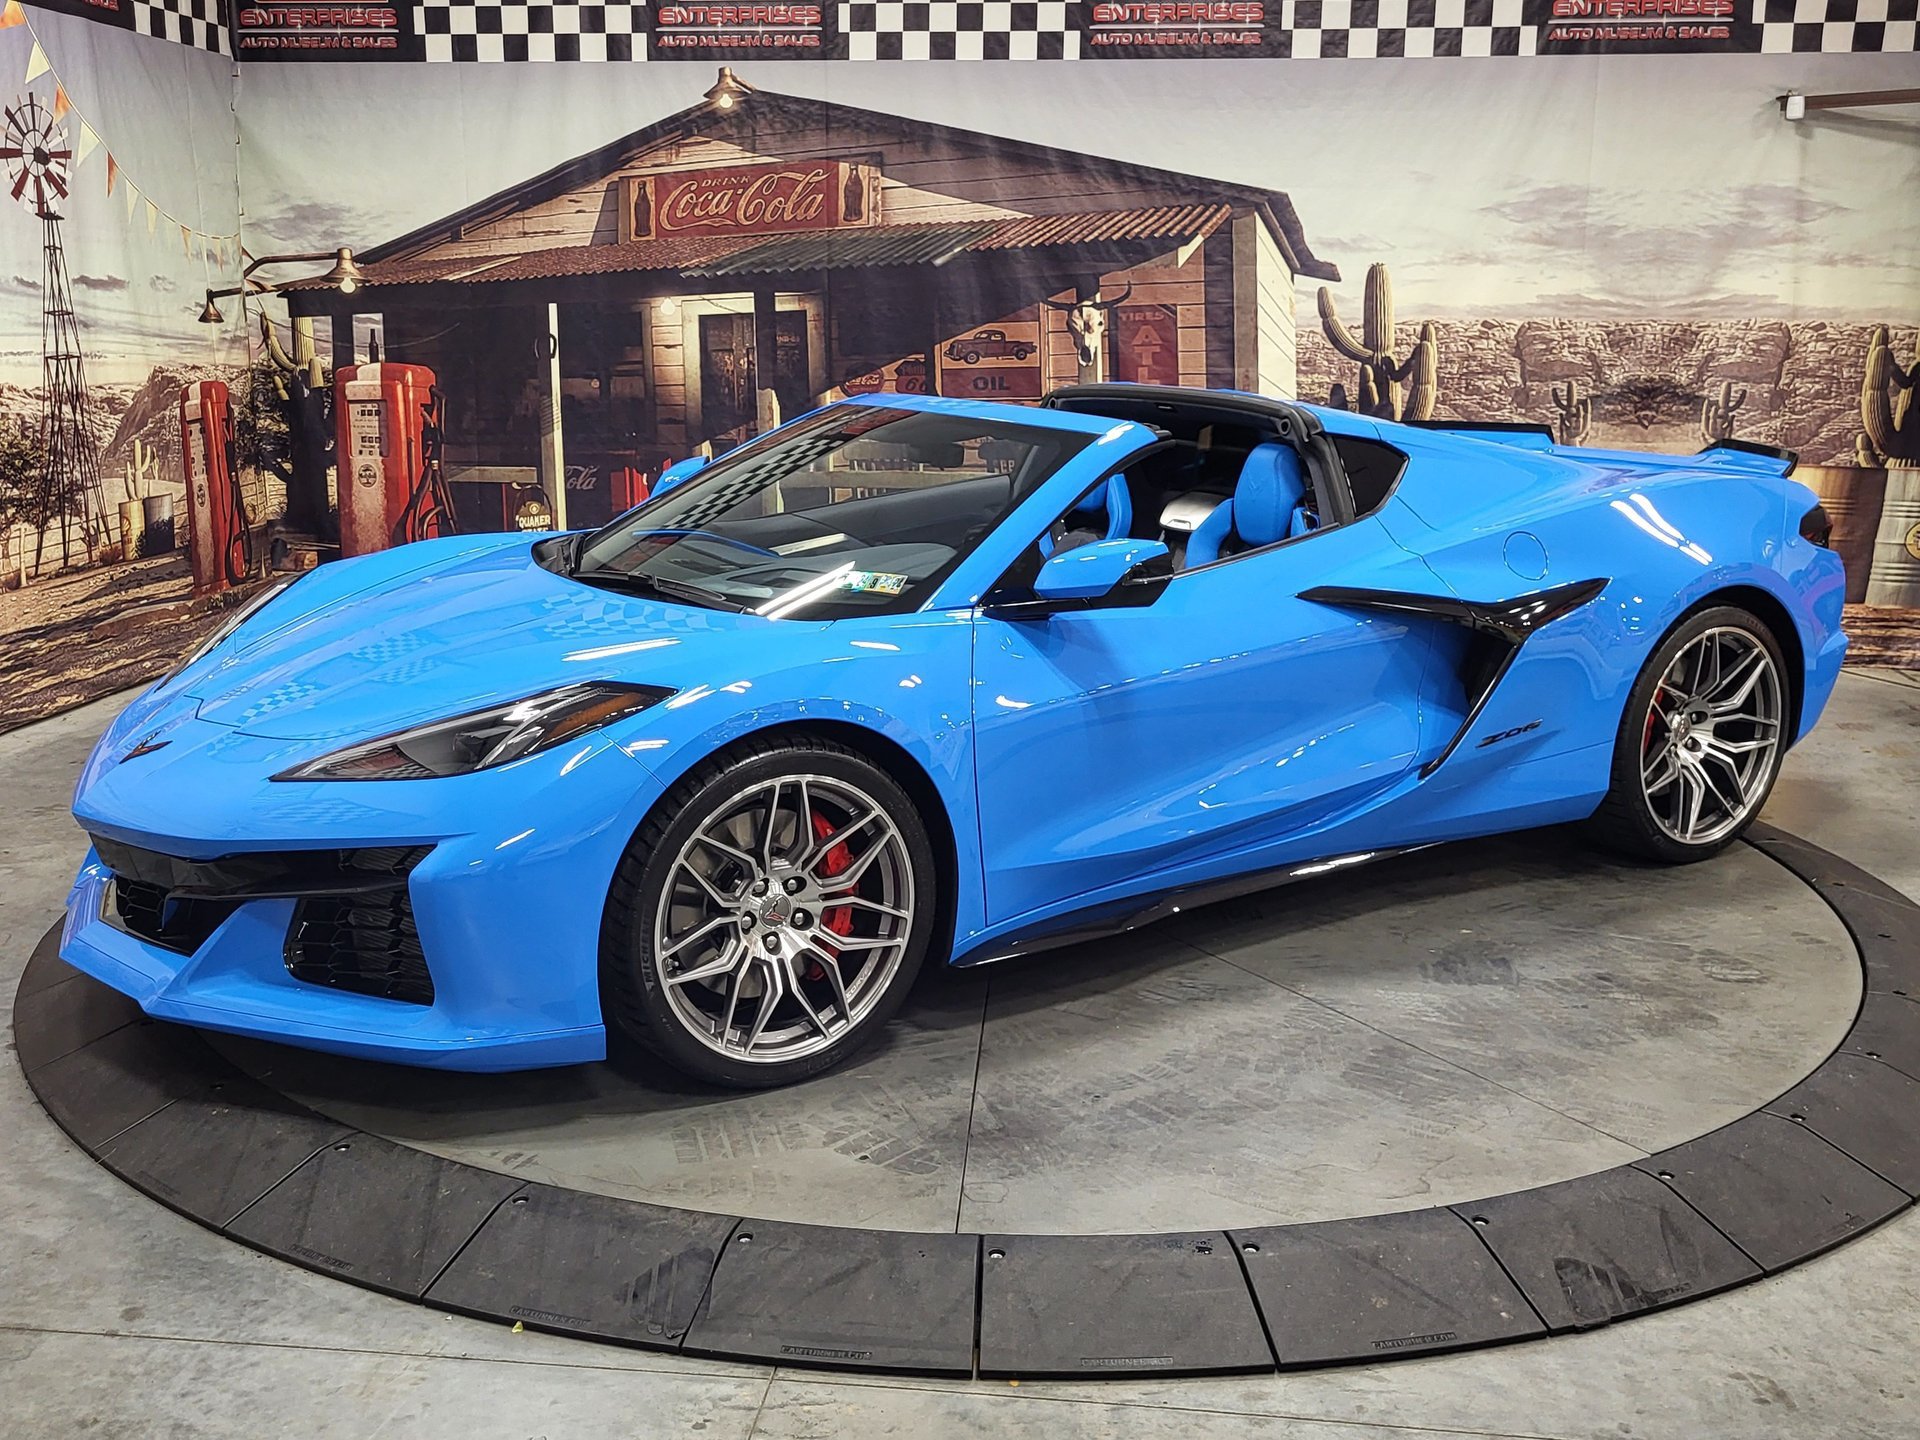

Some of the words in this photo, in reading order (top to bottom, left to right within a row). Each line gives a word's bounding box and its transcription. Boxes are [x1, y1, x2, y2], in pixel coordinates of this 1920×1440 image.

[658, 6, 821, 24] ENTERPRISES
[1093, 3, 1264, 21] ENTERPRISES
[1553, 0, 1734, 16] ENTERPRISES
[240, 9, 398, 26] ENTERPRISES
[658, 36, 697, 47] AUTO
[700, 36, 760, 47] MUSEUM
[762, 34, 772, 46] &
[774, 35, 820, 46] SALES
[1091, 34, 1132, 45] AUTO
[1134, 33, 1198, 45] MUSEUM
[1201, 32, 1211, 44] &
[1213, 32, 1262, 44] SALES
[1549, 29, 1592, 40] AUTO
[1595, 28, 1663, 40] MUSEUM
[1665, 27, 1676, 39] &
[1679, 27, 1730, 39] SALES
[240, 37, 279, 48] AUTO
[281, 37, 339, 48] MUSEUM
[341, 36, 351, 48] &
[353, 37, 397, 48] SALES
[701, 175, 750, 187] DRINK
[659, 168, 832, 231] Coca-Cola
[1120, 311, 1164, 321] TIRES
[973, 376, 1011, 391] OIL
[518, 514, 551, 529] QUAKER
